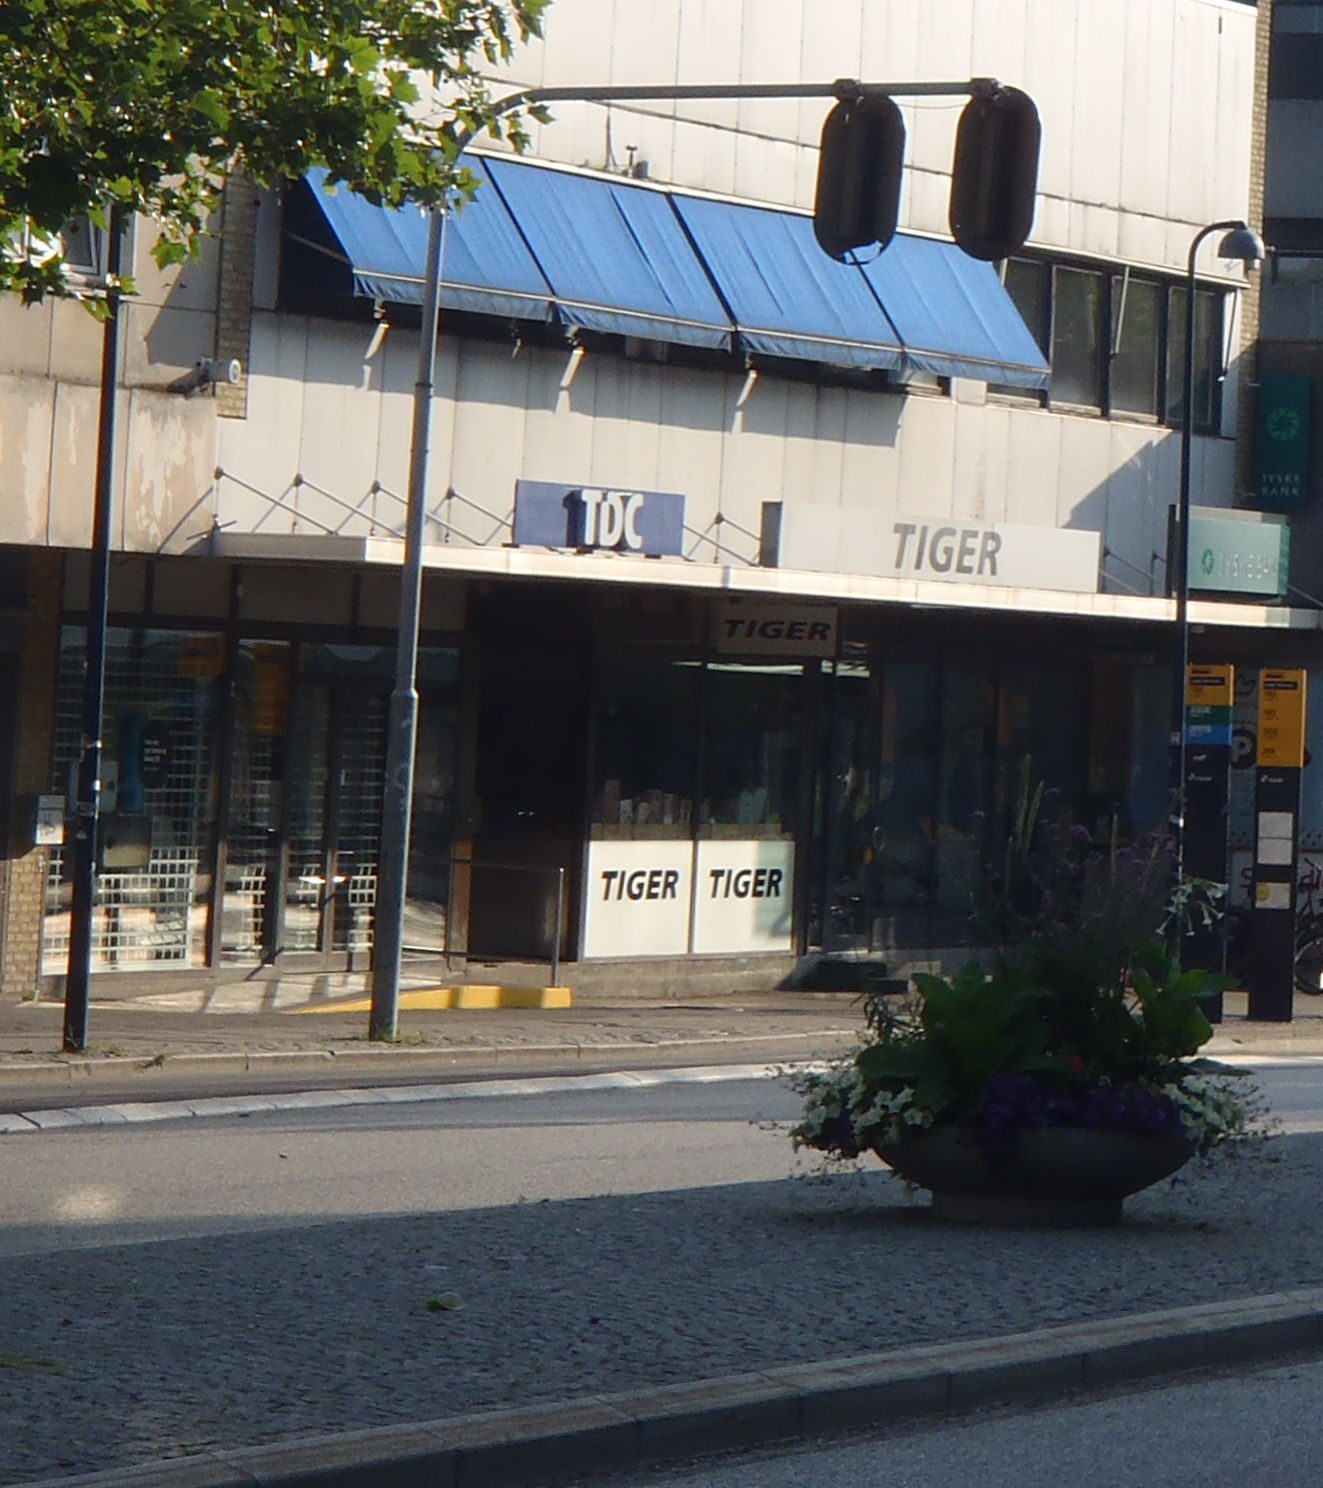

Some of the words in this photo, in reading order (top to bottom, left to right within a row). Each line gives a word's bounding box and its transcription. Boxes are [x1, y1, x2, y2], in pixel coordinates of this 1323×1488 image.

[581, 488, 644, 550] TDC
[893, 522, 1003, 577] TIGER
[723, 618, 832, 641] TIGER
[601, 869, 680, 901] TIGER
[709, 868, 783, 899] TIGER
